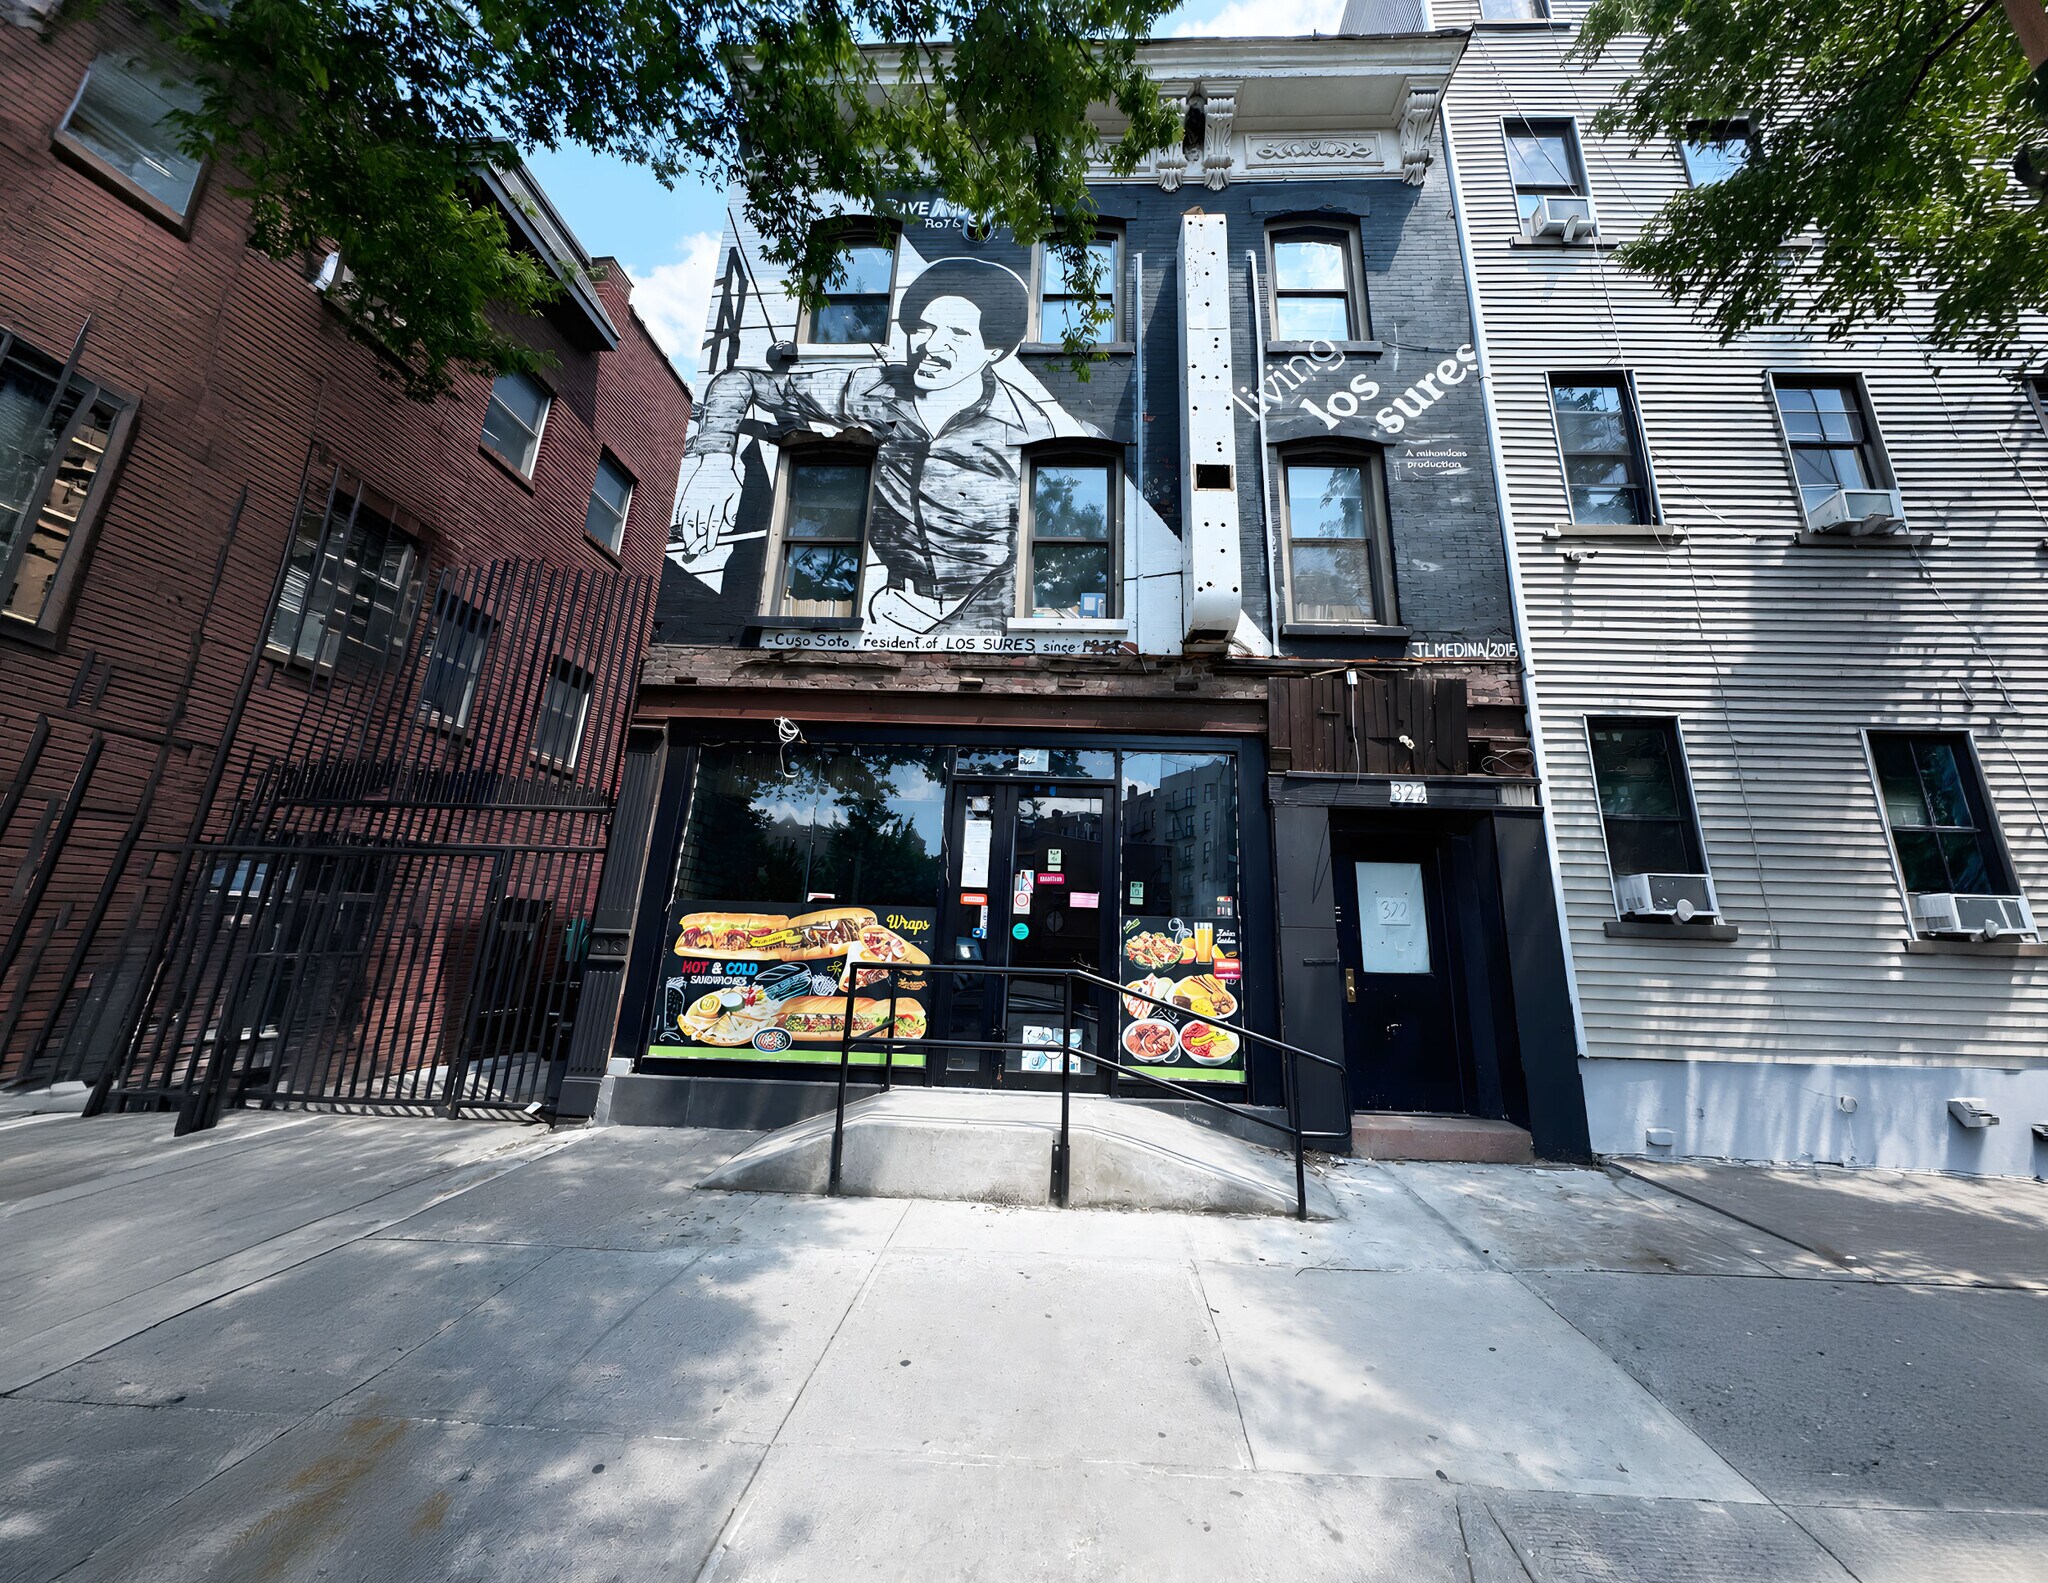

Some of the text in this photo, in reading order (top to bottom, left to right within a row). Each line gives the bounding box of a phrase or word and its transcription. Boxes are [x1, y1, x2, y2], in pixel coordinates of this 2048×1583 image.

[1233, 338, 1346, 421] living
[1375, 343, 1478, 434] sures
[1300, 373, 1379, 431] los
[1407, 460, 1462, 469] production
[925, 636, 939, 649] of
[946, 638, 976, 650] LOS
[983, 638, 1036, 651] SURES
[1043, 639, 1076, 654] since
[886, 914, 930, 936] Wraps
[682, 961, 758, 975] HOT & COLD
